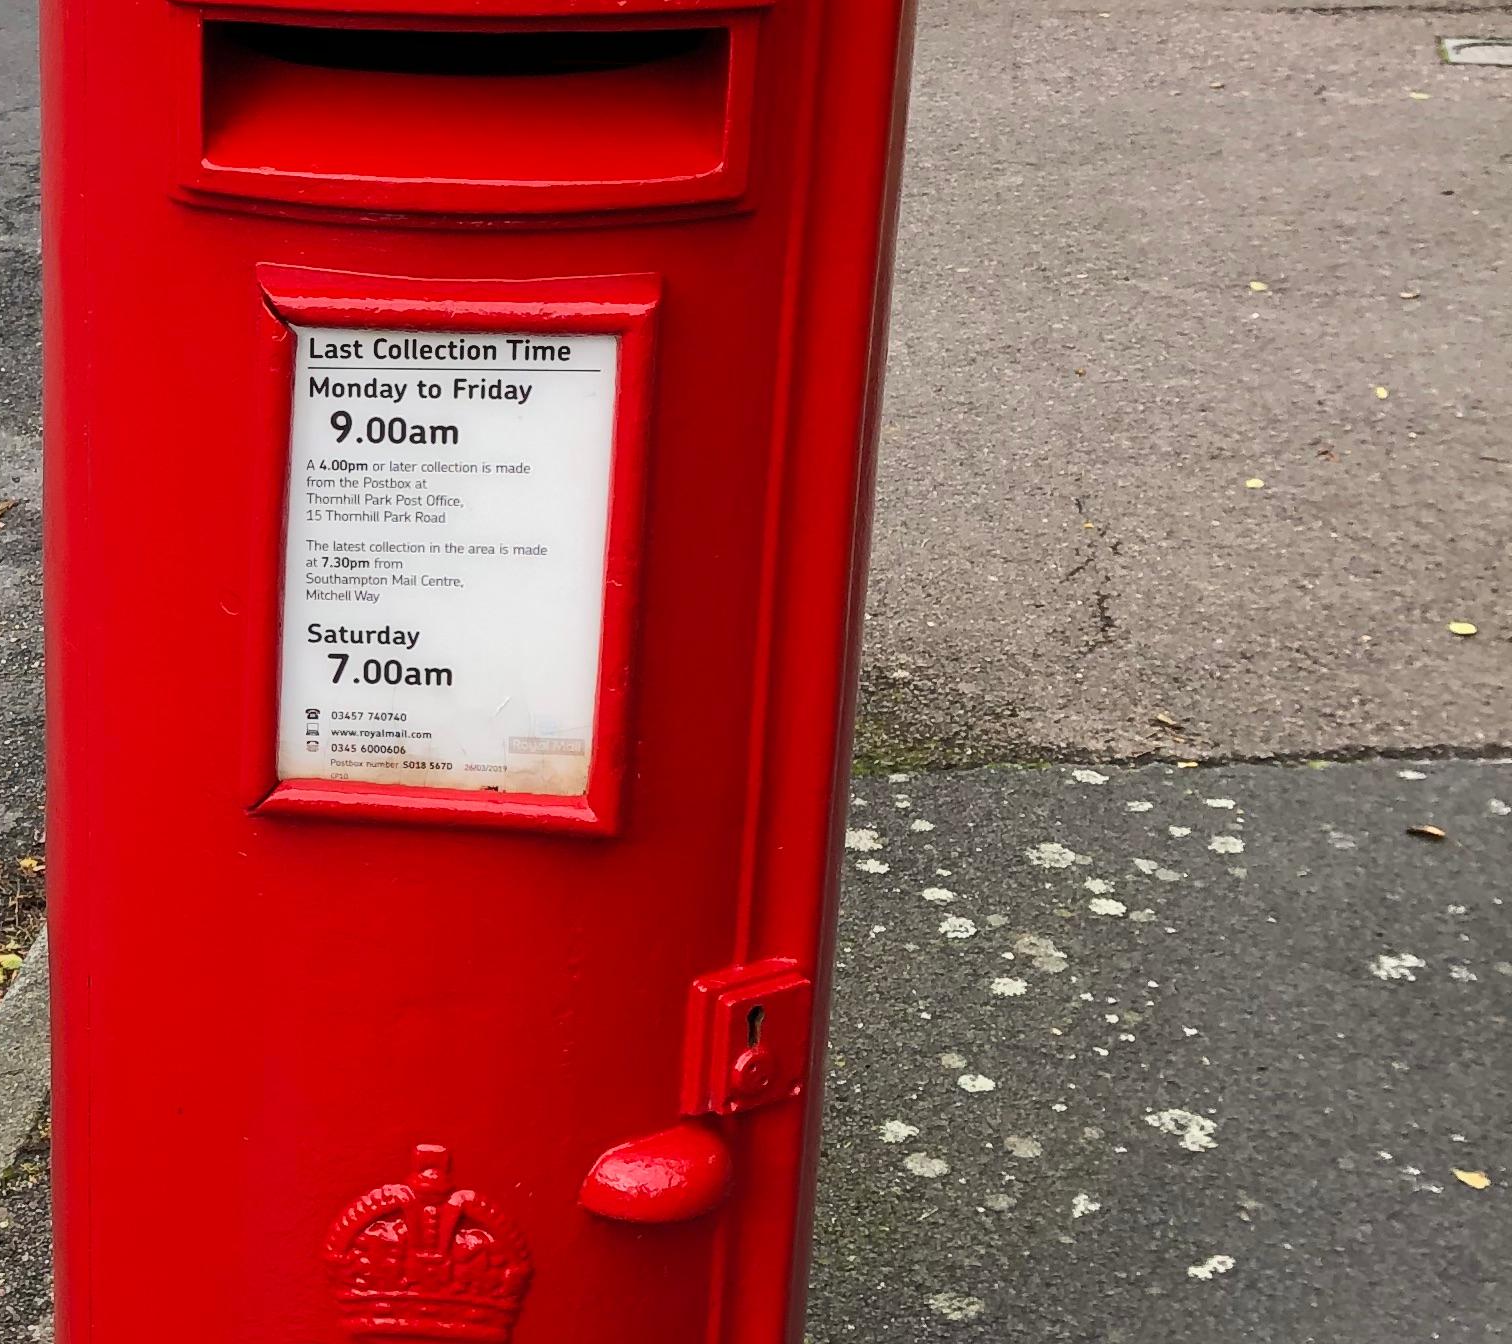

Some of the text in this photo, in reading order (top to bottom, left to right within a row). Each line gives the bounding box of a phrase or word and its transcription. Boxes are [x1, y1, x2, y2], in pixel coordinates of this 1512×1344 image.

[309, 337, 572, 362] Last Collection Time
[309, 376, 533, 405] Monday to Friday
[330, 410, 459, 445] 9.00am
[306, 458, 531, 475] A 4.00pm or later collection is made
[306, 475, 428, 490] from the Postbox at
[305, 492, 464, 508] Thornhill Park Post Office,
[306, 509, 446, 524] 15 Thornhill Park Road
[305, 539, 548, 556] The latest collection in the area is made
[305, 556, 403, 571] at 7.30pm from
[305, 572, 464, 590] Southampton Mail Centre,
[306, 588, 381, 605] Mitchell Way
[307, 623, 420, 650] Saturday
[327, 653, 453, 687] 7.00am
[331, 711, 407, 722] 03457 740740
[330, 729, 432, 740] www.royalmail.com
[331, 743, 407, 755] 0345 6000606
[330, 758, 364, 768] Postbox
[365, 760, 400, 769] number
